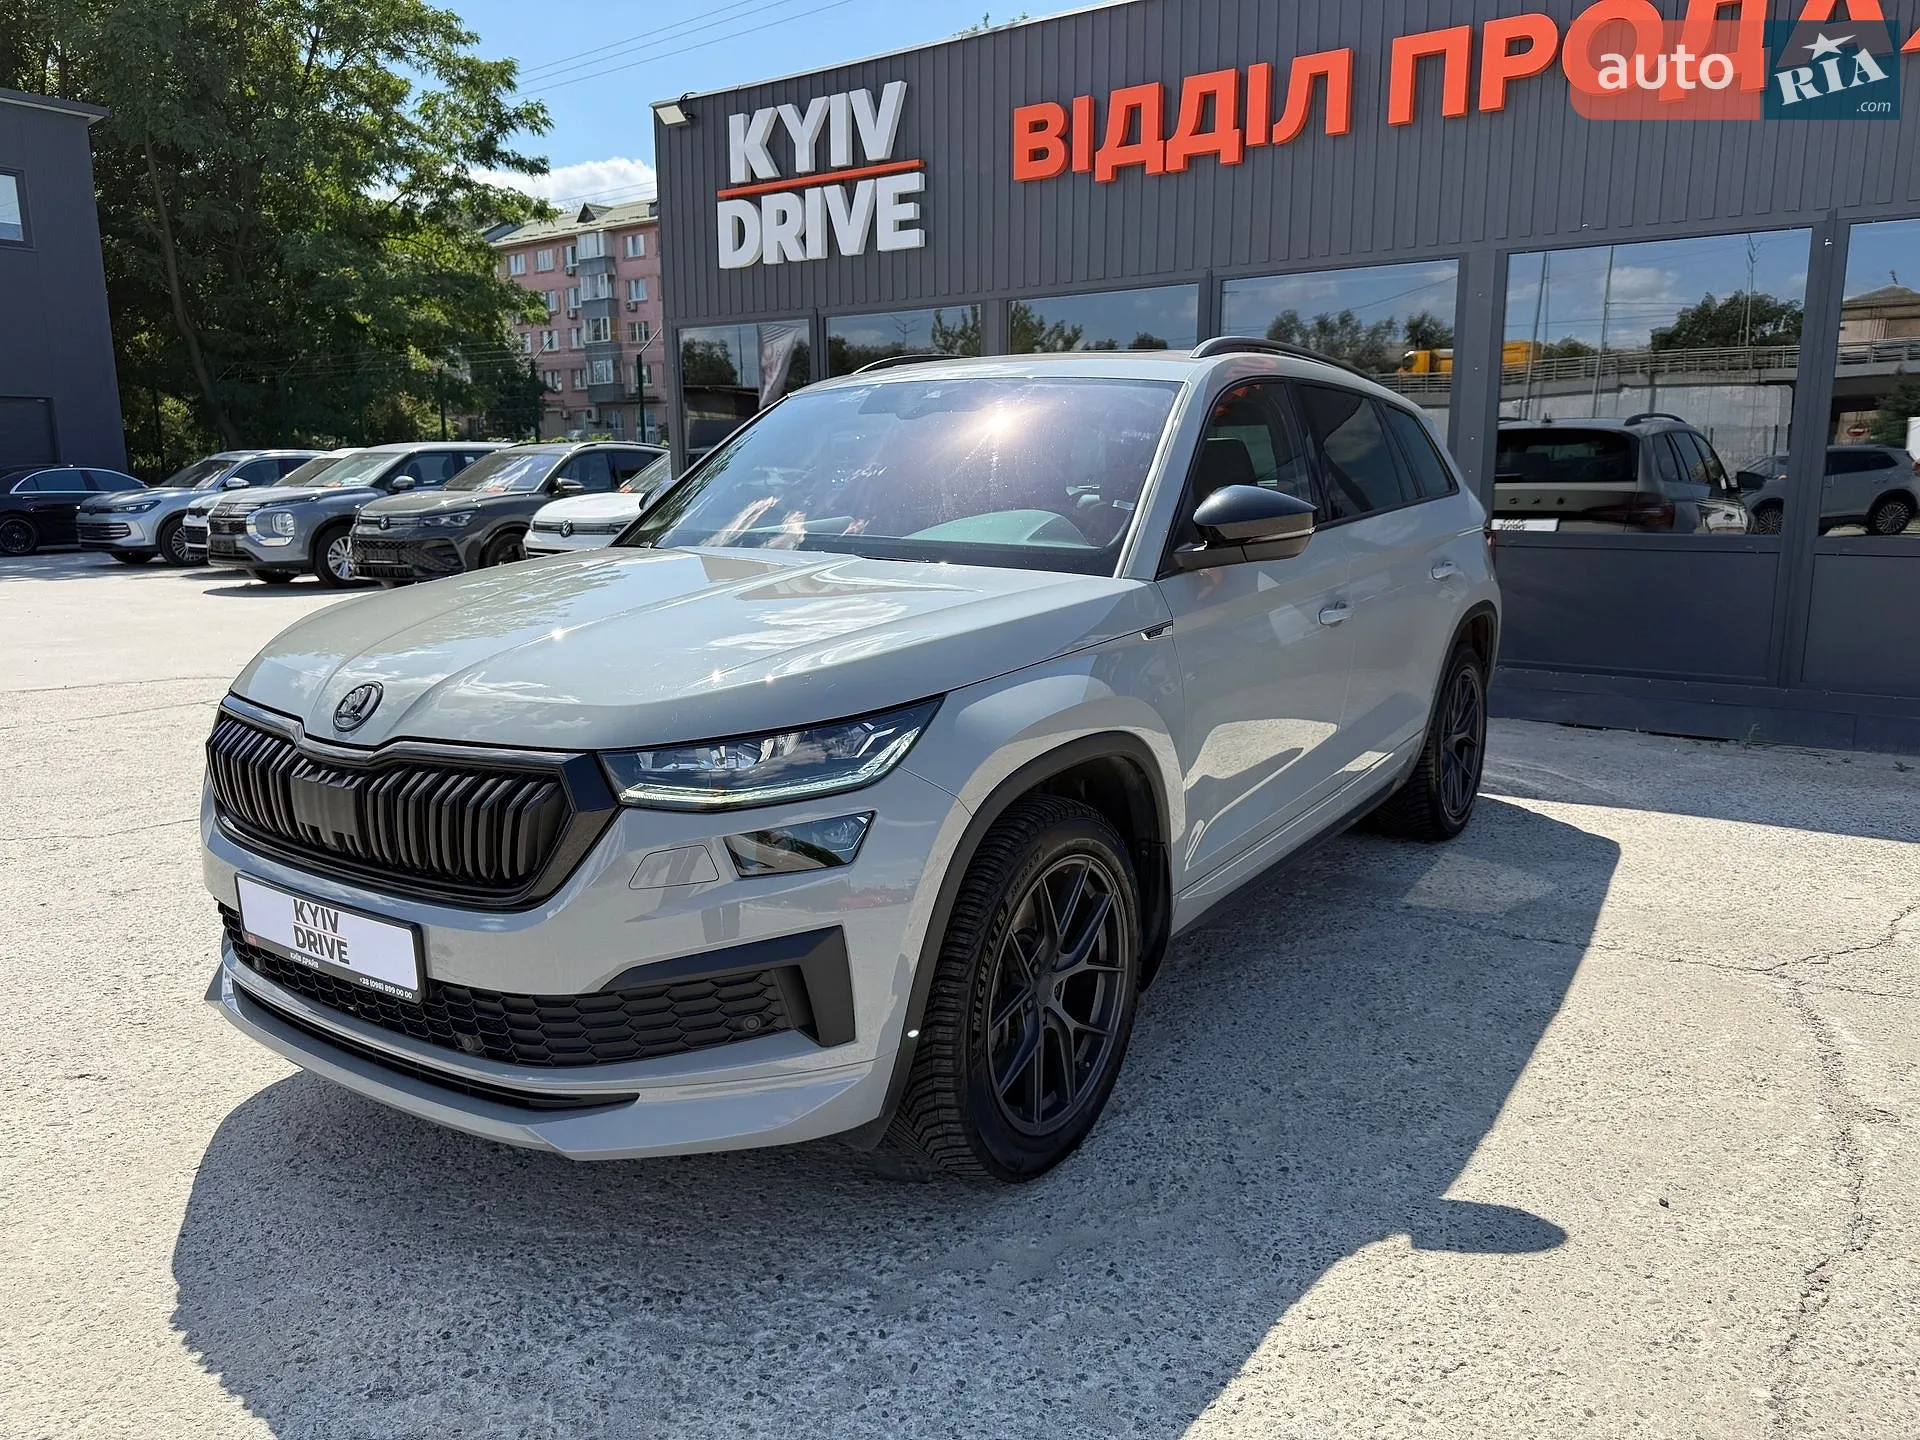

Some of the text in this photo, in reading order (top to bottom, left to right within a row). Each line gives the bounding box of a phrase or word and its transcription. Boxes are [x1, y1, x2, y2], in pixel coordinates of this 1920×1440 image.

[728, 81, 907, 184] KYIV
[1013, 0, 1920, 183] ВІДДІЛ ПРОДА
[717, 172, 926, 269] DRIVE
[292, 898, 339, 934] KYIV
[293, 925, 350, 965] DRIVE
[972, 905, 1007, 1033] MICHELIN
